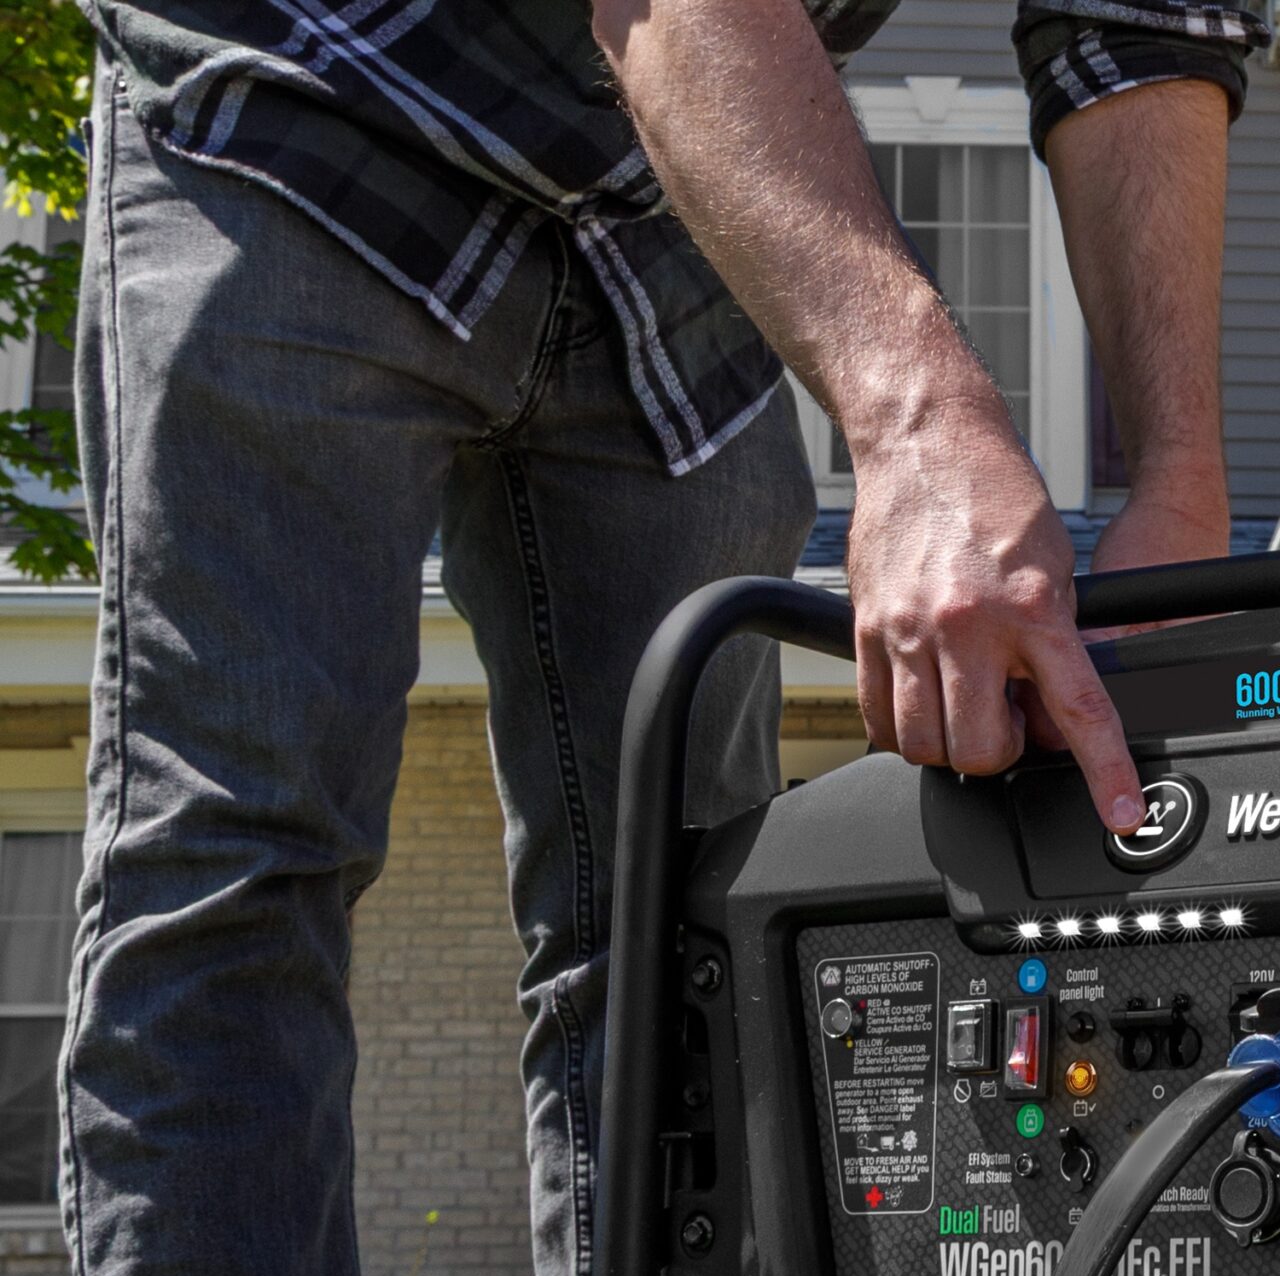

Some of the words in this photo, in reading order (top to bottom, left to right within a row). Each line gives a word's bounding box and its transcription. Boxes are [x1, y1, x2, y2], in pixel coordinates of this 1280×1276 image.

[1236, 706, 1275, 718] Running
[845, 962, 891, 975] AUTOMATIC
[1066, 966, 1099, 982] Control
[845, 974, 865, 985] HIGH
[866, 972, 897, 983] LEVELS
[899, 971, 910, 981] OF
[1249, 969, 1275, 982] 120V
[844, 984, 879, 996] CARBON
[881, 981, 924, 993] MONOXIDE
[1059, 985, 1083, 1003] panel
[1084, 984, 1105, 1002] light
[867, 999, 881, 1008] RED
[867, 1007, 890, 1016] ACTIVE
[891, 1006, 901, 1015] CO
[902, 1004, 932, 1014] SHUTOFF
[906, 1014, 914, 1023] de
[914, 1013, 925, 1022] CO
[912, 1022, 921, 1031] du
[921, 1022, 932, 1030] CO
[854, 1038, 883, 1048] YELLOW
[854, 1046, 883, 1057] SERVICE
[884, 1044, 926, 1055] GENERATOR
[834, 1079, 862, 1089] BEFORE
[863, 1077, 906, 1088] RESTARTING
[906, 1078, 925, 1086] move
[835, 1089, 866, 1099] generator
[866, 1088, 874, 1096] to
[897, 1087, 915, 1097] open
[897, 1095, 924, 1104] exhaust
[869, 1104, 899, 1114] DANGER
[899, 1103, 916, 1112] label
[838, 1115, 850, 1124] and
[851, 1114, 877, 1125] product
[877, 1113, 901, 1122] manual
[901, 1112, 912, 1121] for
[1247, 1116, 1268, 1128] 240
[844, 1157, 864, 1167] MOVE
[865, 1156, 875, 1166] TO
[875, 1155, 899, 1165] FRESH
[899, 1155, 912, 1164] AIR
[912, 1154, 928, 1164] AND
[968, 1153, 980, 1167] EFI
[981, 1152, 1011, 1169] System
[845, 1166, 860, 1176] GET
[860, 1165, 890, 1175] MEDICAL
[891, 1164, 910, 1174] HELP
[910, 1163, 917, 1173] if
[917, 1165, 930, 1175] you
[966, 1170, 985, 1184] Fault
[986, 1169, 1012, 1185] Status
[1179, 1186, 1209, 1203] Ready
[939, 1204, 980, 1236] Dual
[983, 1203, 1021, 1234] Fuel
